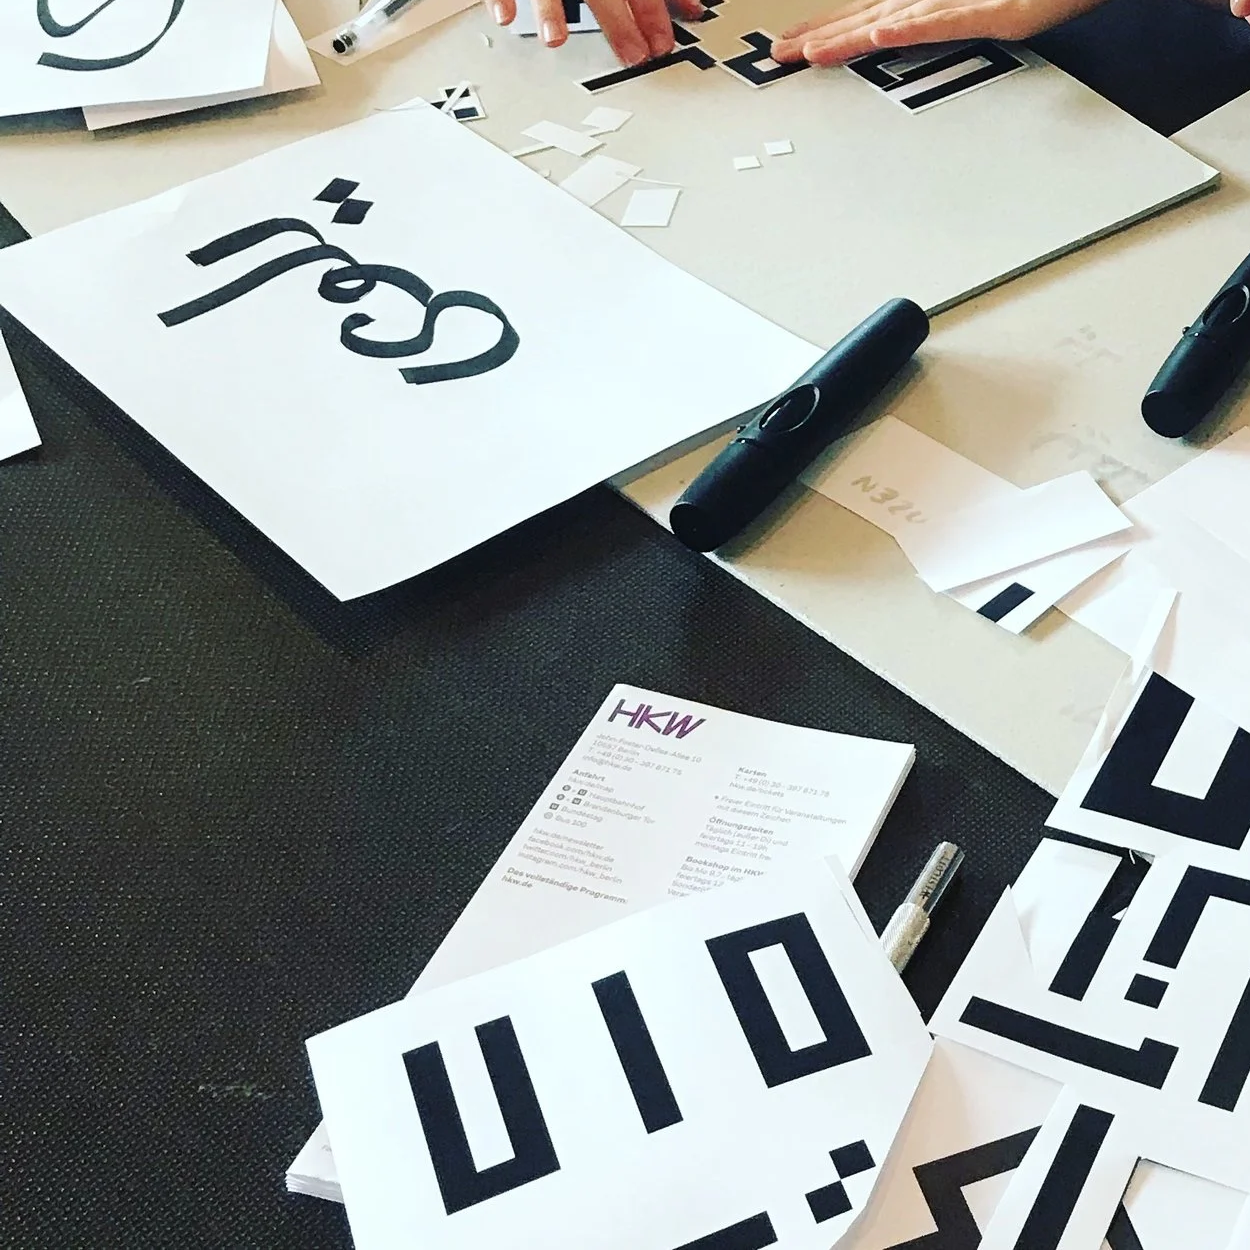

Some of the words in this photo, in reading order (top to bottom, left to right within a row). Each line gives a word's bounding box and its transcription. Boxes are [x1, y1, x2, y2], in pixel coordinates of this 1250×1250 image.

[607, 698, 707, 740] HKW
[572, 769, 606, 782] Anfahrt
[738, 766, 768, 778] Karten
[561, 805, 604, 823] Bundestag
[583, 800, 642, 821] Brandenburger
[784, 808, 848, 826] Veranstaltungen
[571, 818, 588, 829] 100
[708, 816, 774, 836] Öffnungszeiten
[685, 855, 730, 872] Bookshop
[501, 874, 533, 889] hkw.de
[507, 867, 524, 878] Das
[525, 872, 579, 893] vollständige
[579, 885, 629, 904] Programm:
